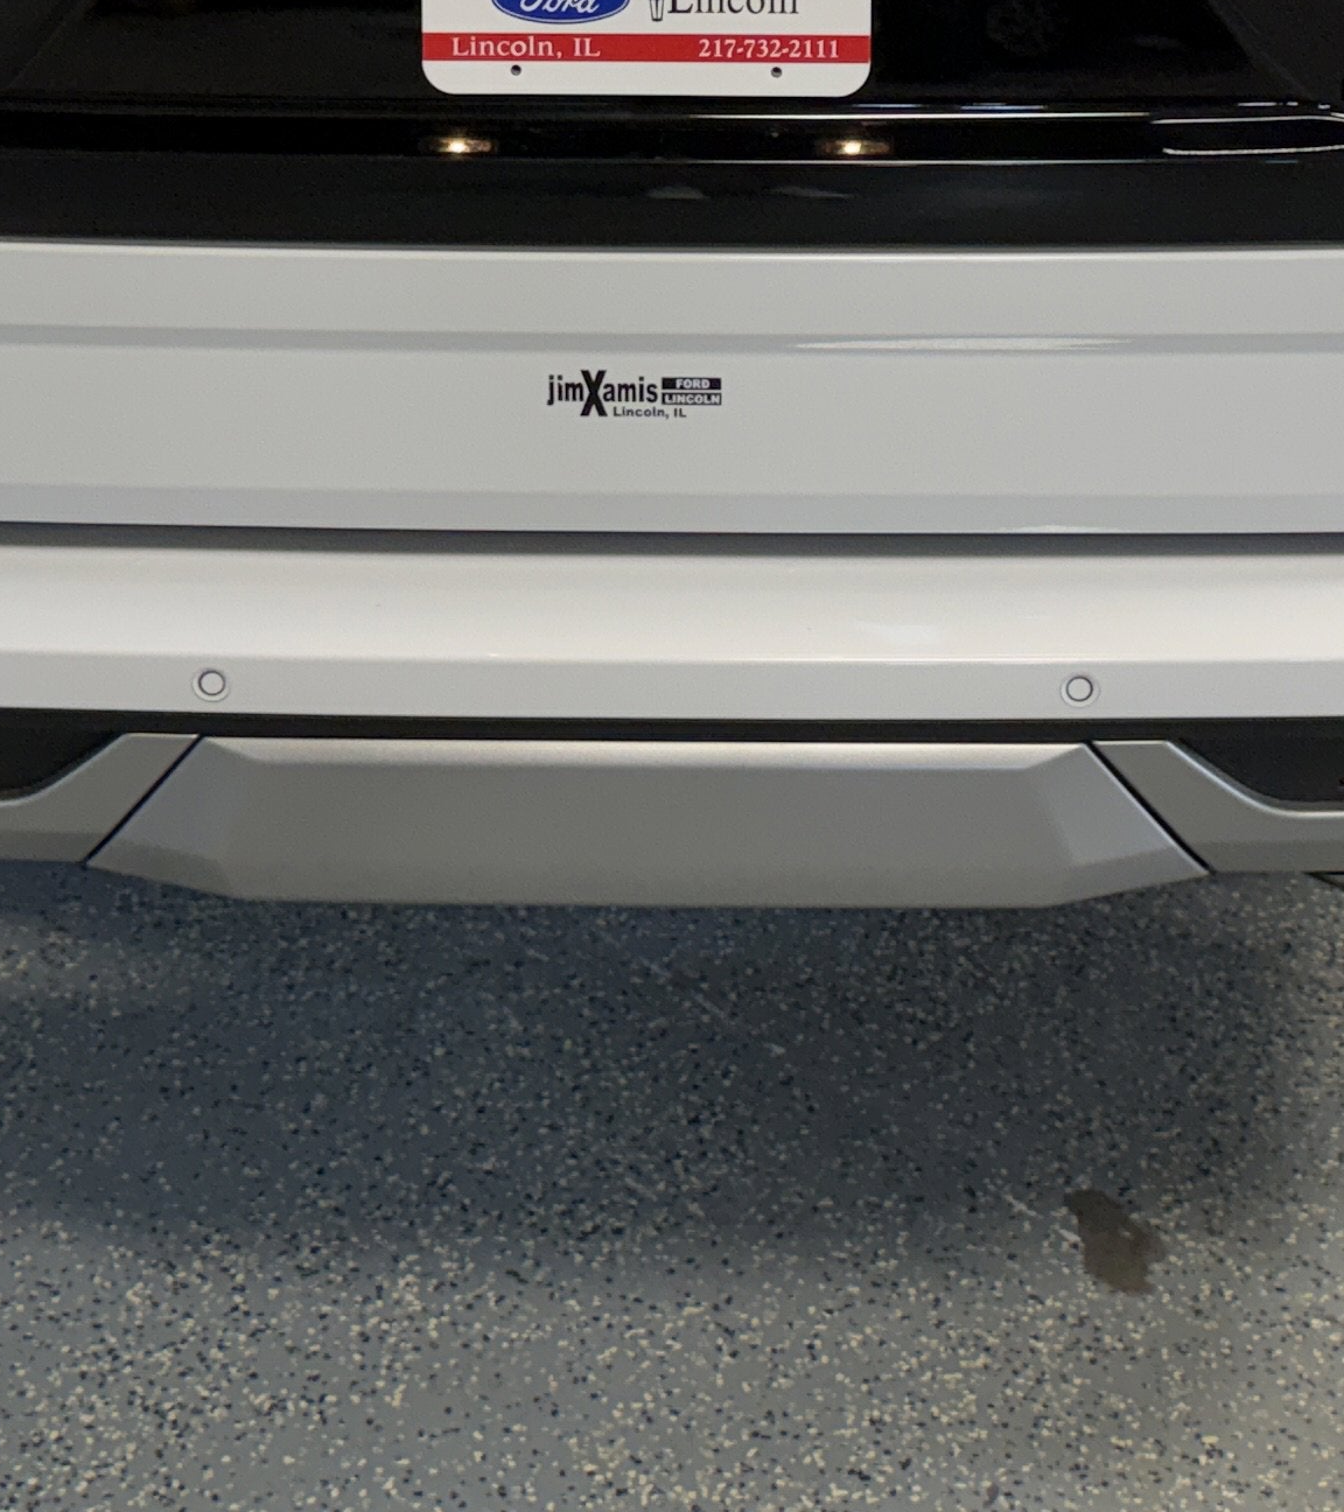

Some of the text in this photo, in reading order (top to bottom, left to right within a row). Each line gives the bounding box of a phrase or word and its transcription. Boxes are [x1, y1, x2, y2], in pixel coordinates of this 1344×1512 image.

[452, 37, 601, 59] Lincoln, IL
[699, 39, 839, 59] 217-732-2111
[675, 378, 710, 389] FORD
[547, 370, 658, 417] jimXamis
[664, 393, 721, 405] LINCOLN
[613, 406, 687, 419] Lincoln, IL
